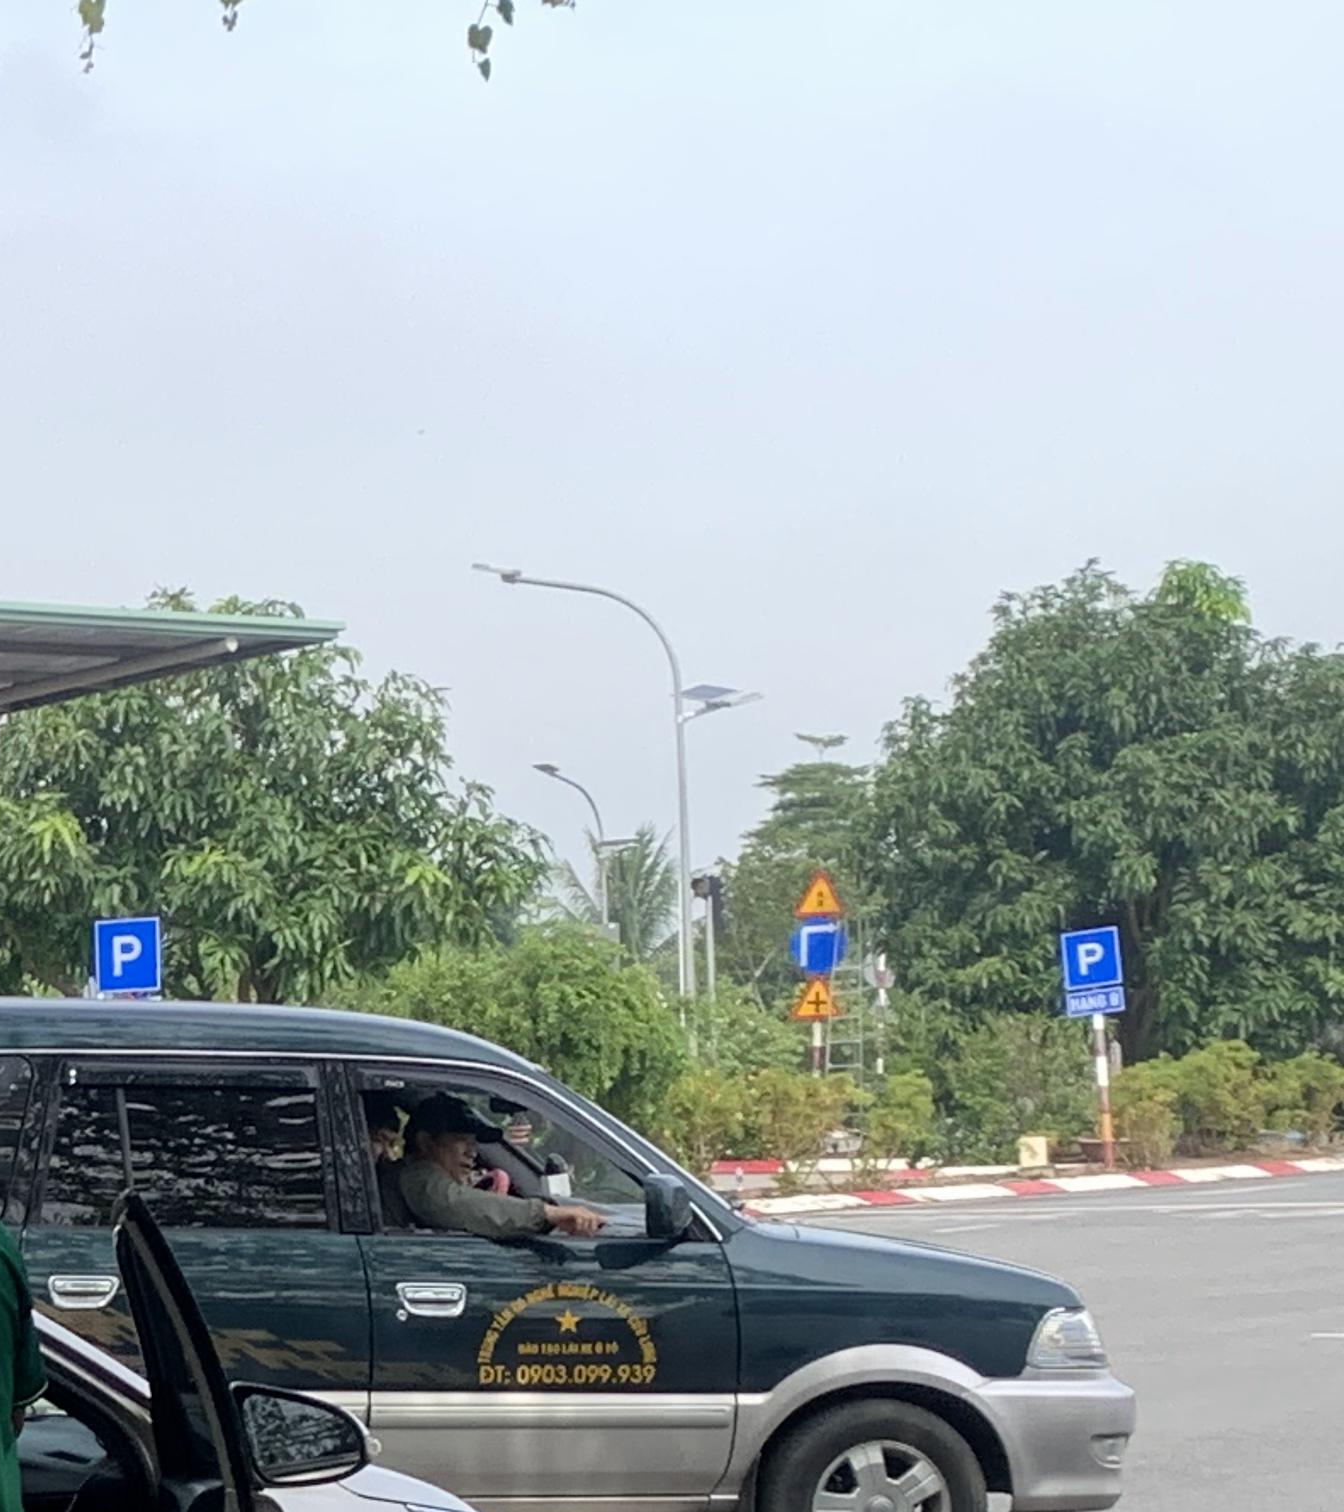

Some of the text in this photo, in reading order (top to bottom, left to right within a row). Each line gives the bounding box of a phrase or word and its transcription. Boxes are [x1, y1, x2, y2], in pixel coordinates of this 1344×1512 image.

[112, 934, 142, 977] P
[1077, 942, 1104, 976] P
[479, 1364, 657, 1385] ĐT: 0903.099.939
